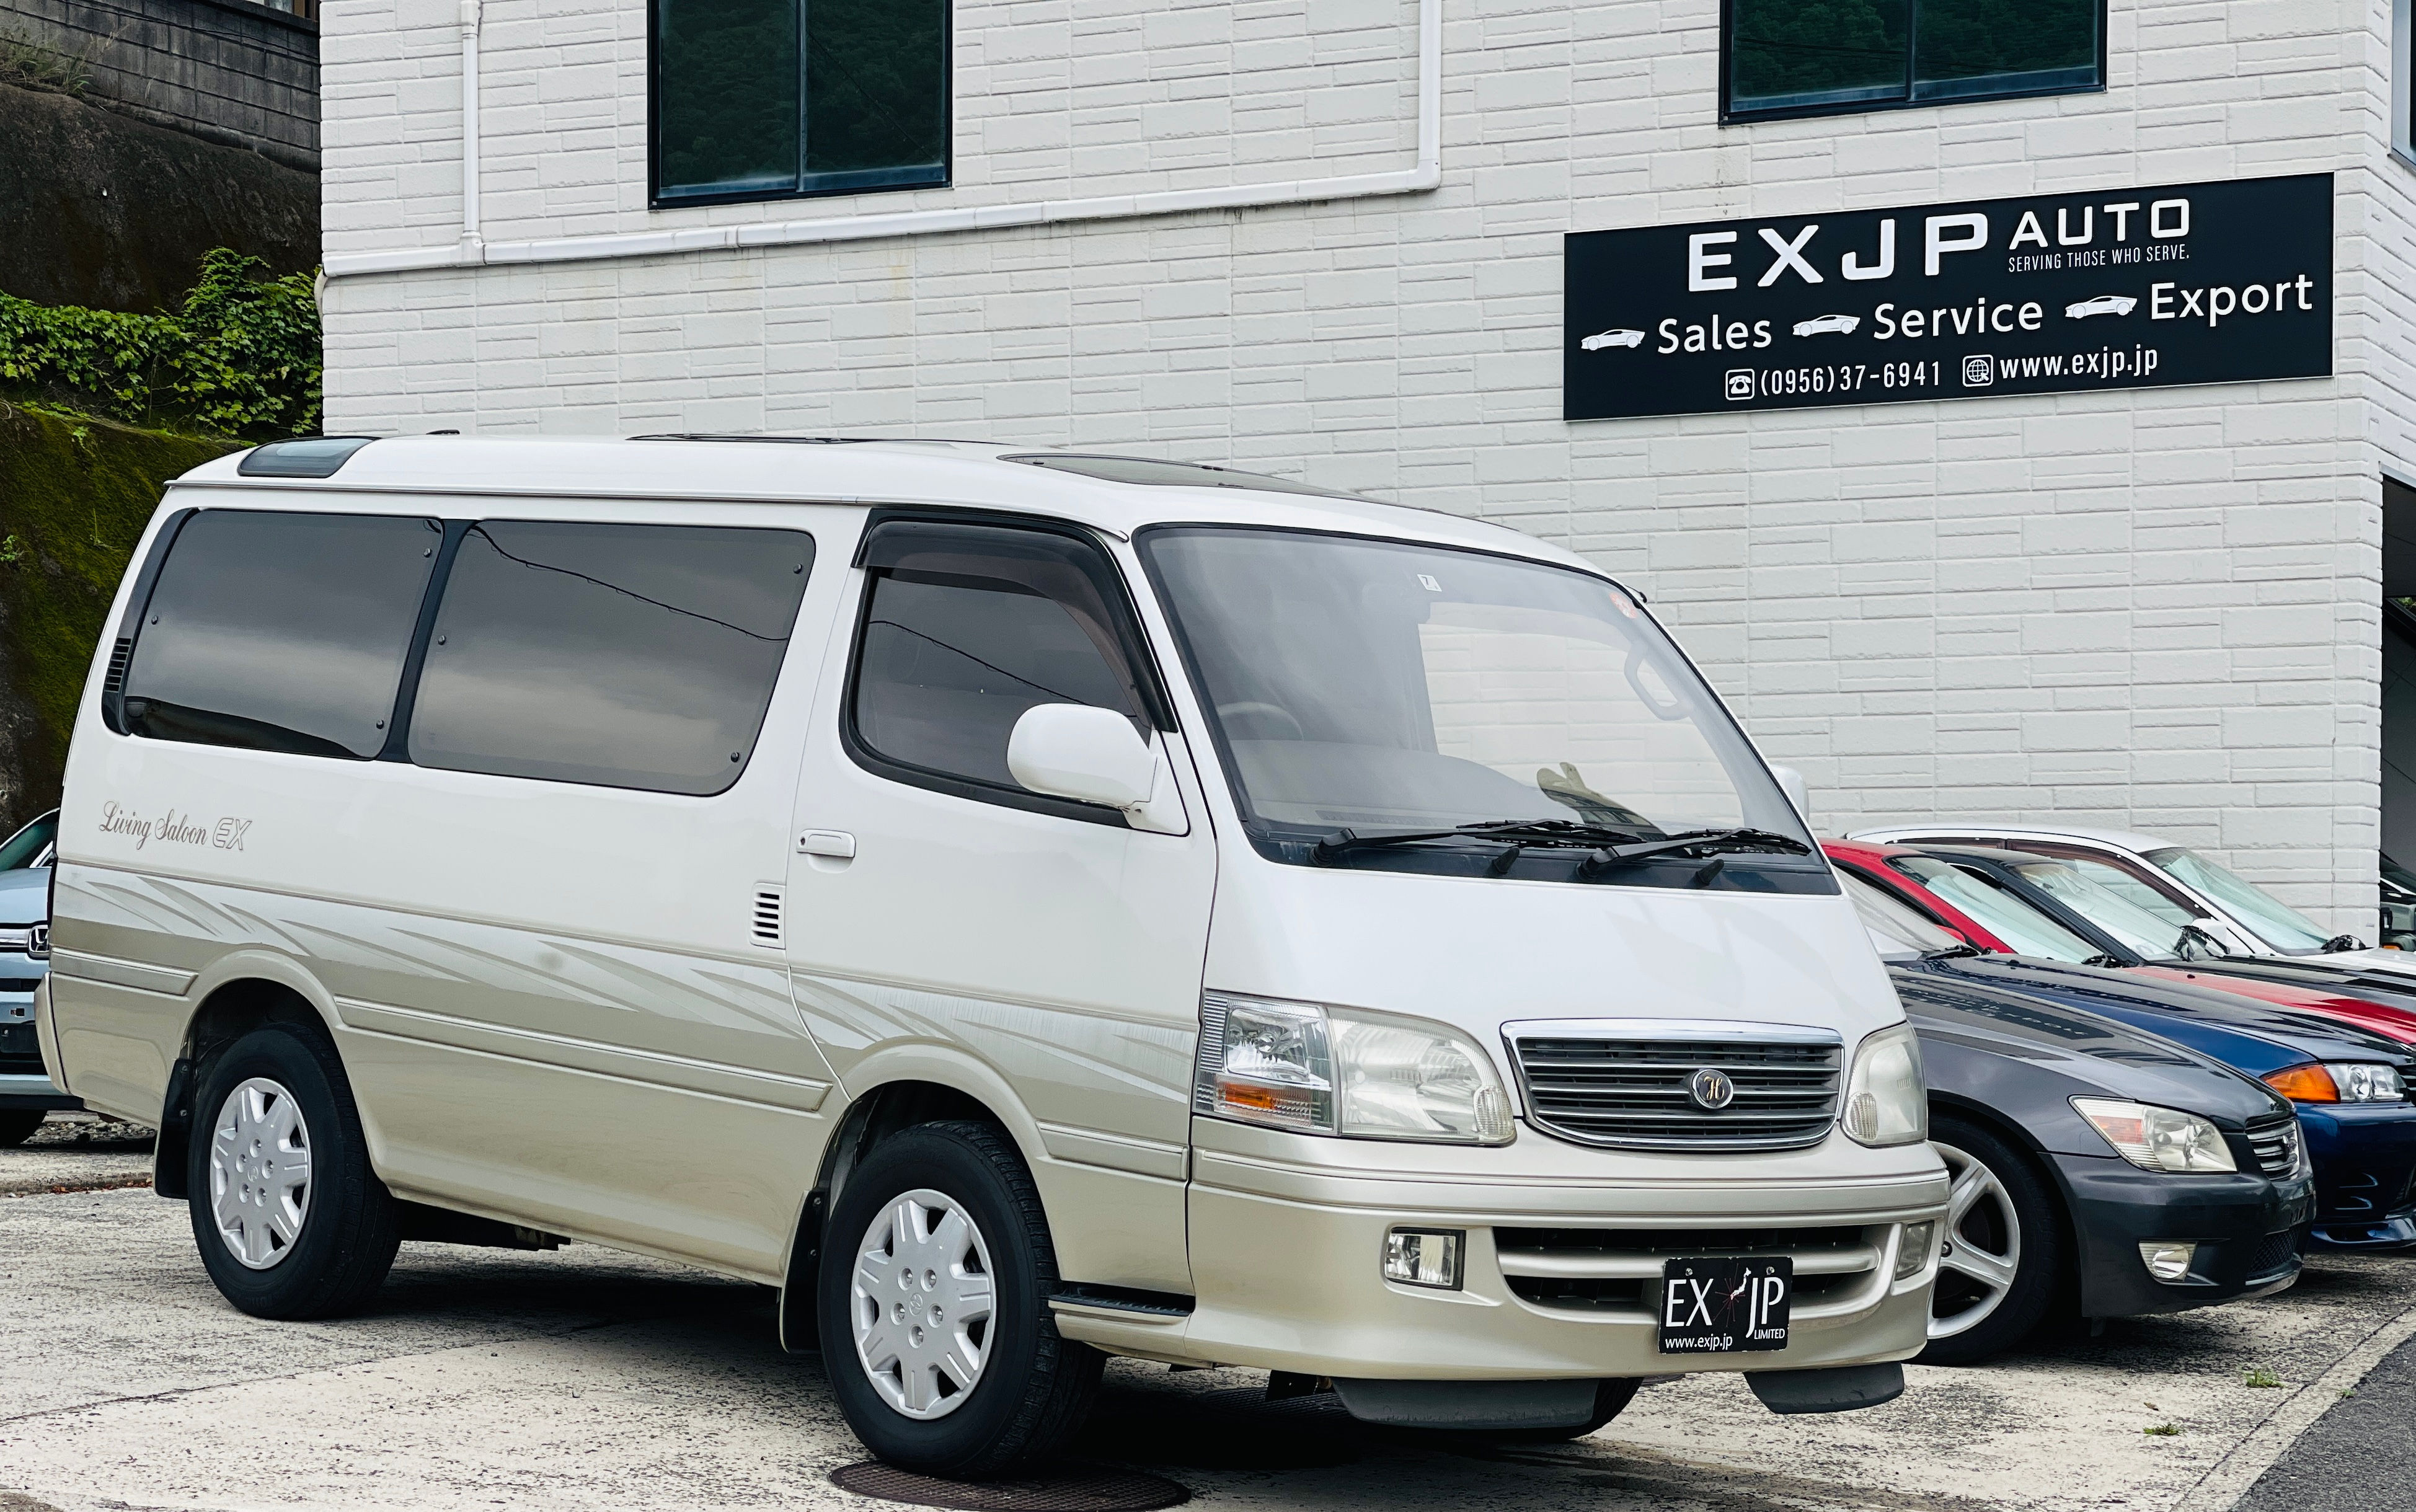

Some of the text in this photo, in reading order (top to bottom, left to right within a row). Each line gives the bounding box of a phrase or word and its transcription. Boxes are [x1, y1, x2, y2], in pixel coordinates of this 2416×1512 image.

[1688, 198, 2190, 292] EXJP AUTO
[2008, 244, 2190, 273] SERVING THOSE WHO SERVE.
[1658, 274, 2314, 355] Sales Service Export
[1761, 344, 2158, 397] (0956)37-6941 www.exjp.jp
[99, 800, 253, 851] Living Saloon EX
[1665, 1276, 1785, 1339] EX JP
[1665, 1333, 1733, 1351] www.exjp.jp
[1754, 1328, 1785, 1340] LIMITED
